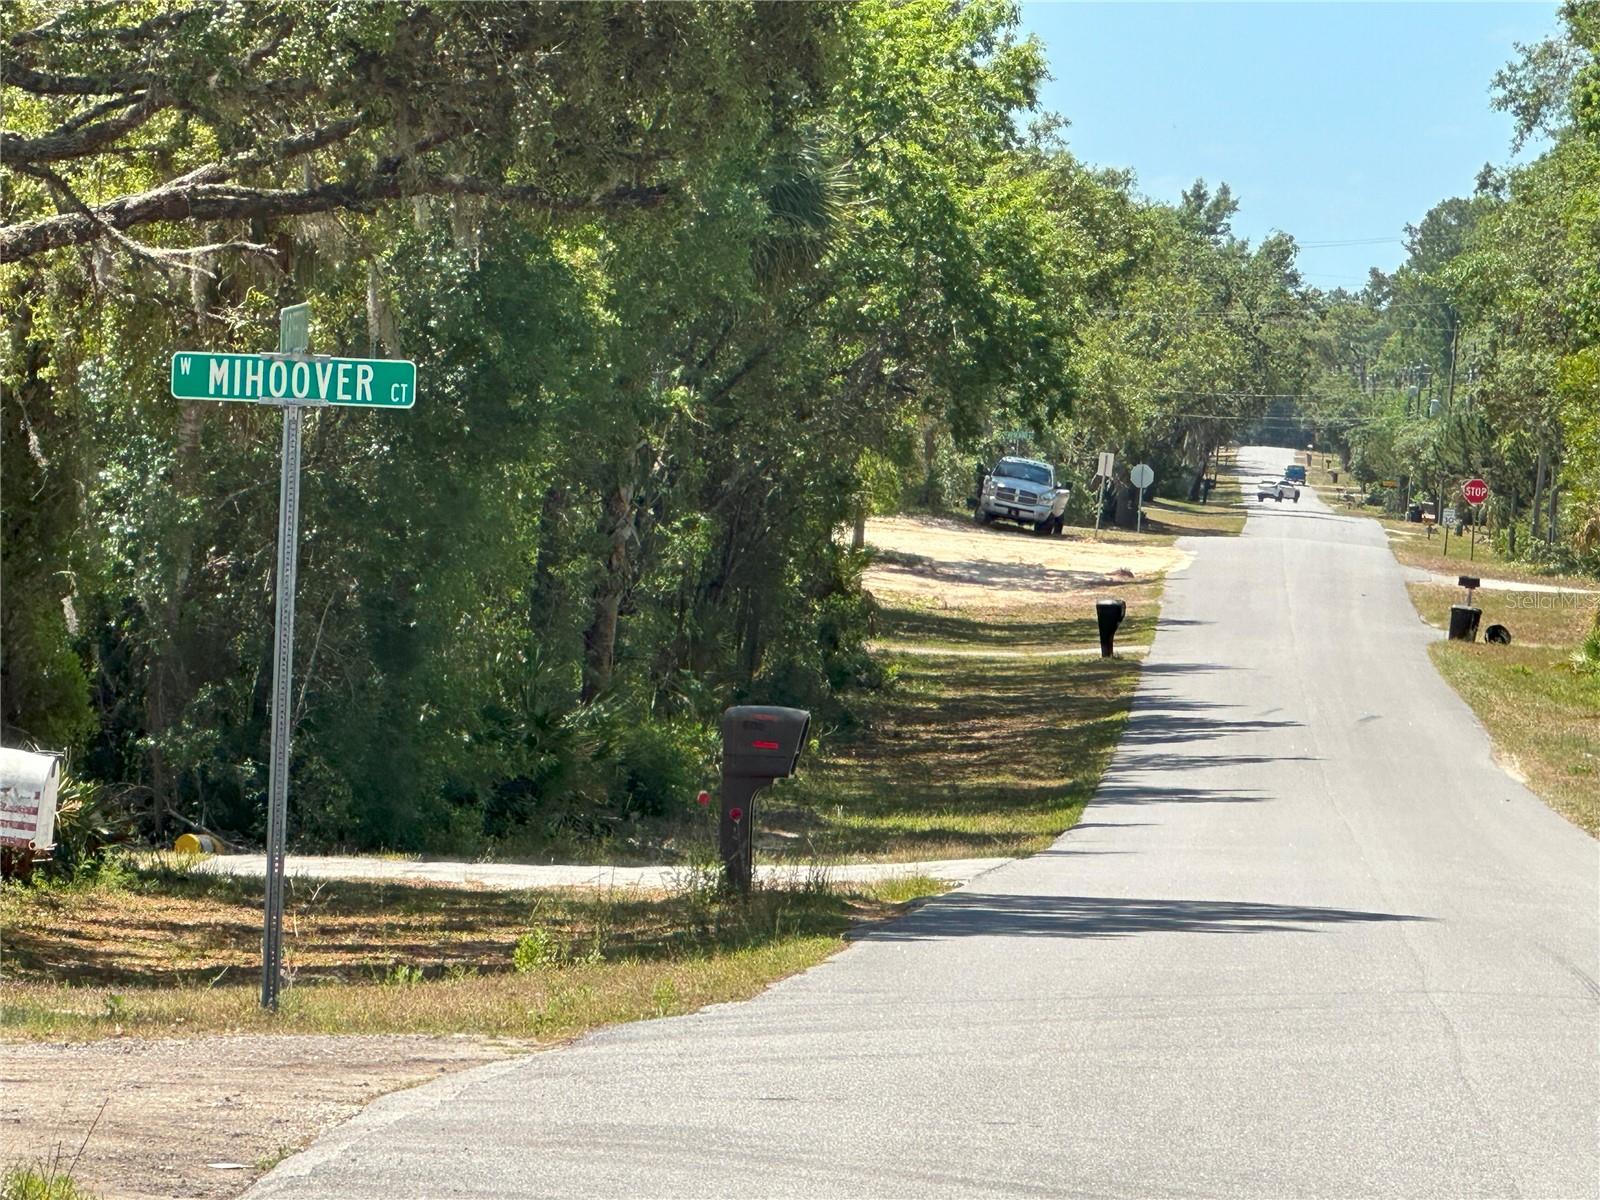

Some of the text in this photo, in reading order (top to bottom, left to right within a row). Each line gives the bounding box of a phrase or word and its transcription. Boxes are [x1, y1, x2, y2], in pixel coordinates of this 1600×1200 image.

[180, 357, 409, 402] W MIHOOVER CT
[1464, 486, 1488, 496] STOP
